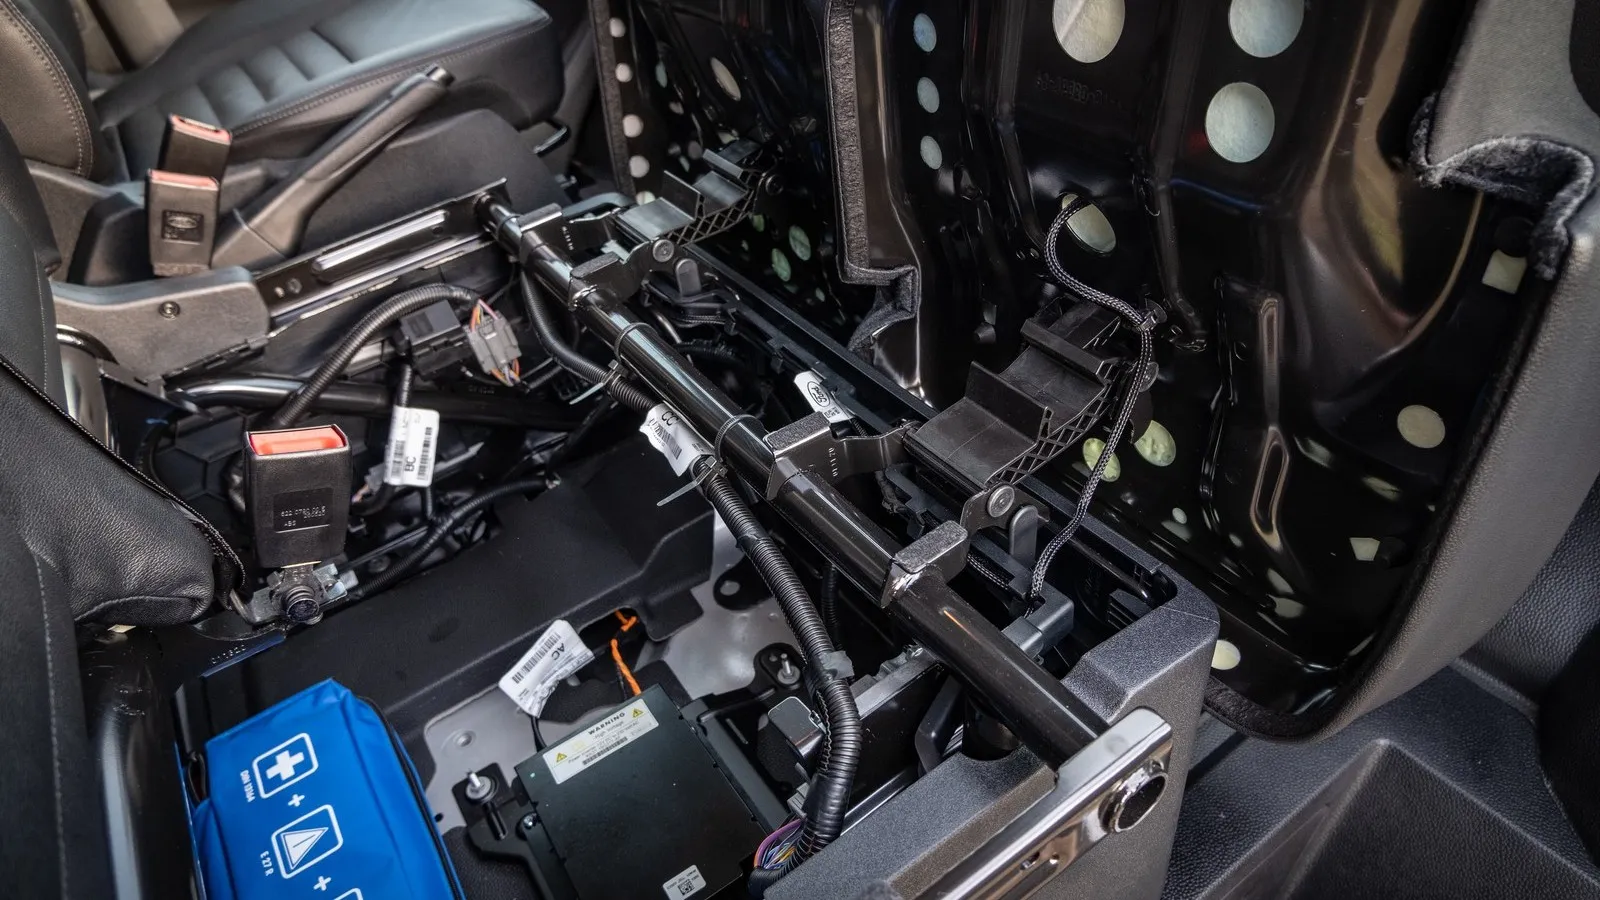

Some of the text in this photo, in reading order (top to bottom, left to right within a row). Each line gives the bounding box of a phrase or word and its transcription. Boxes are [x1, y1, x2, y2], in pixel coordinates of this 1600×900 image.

[661, 410, 679, 427] CC
[404, 456, 417, 472] BC
[551, 642, 565, 661] AC
[588, 711, 626, 735] WARNING
[262, 857, 273, 868] 27
[265, 867, 274, 877] R
